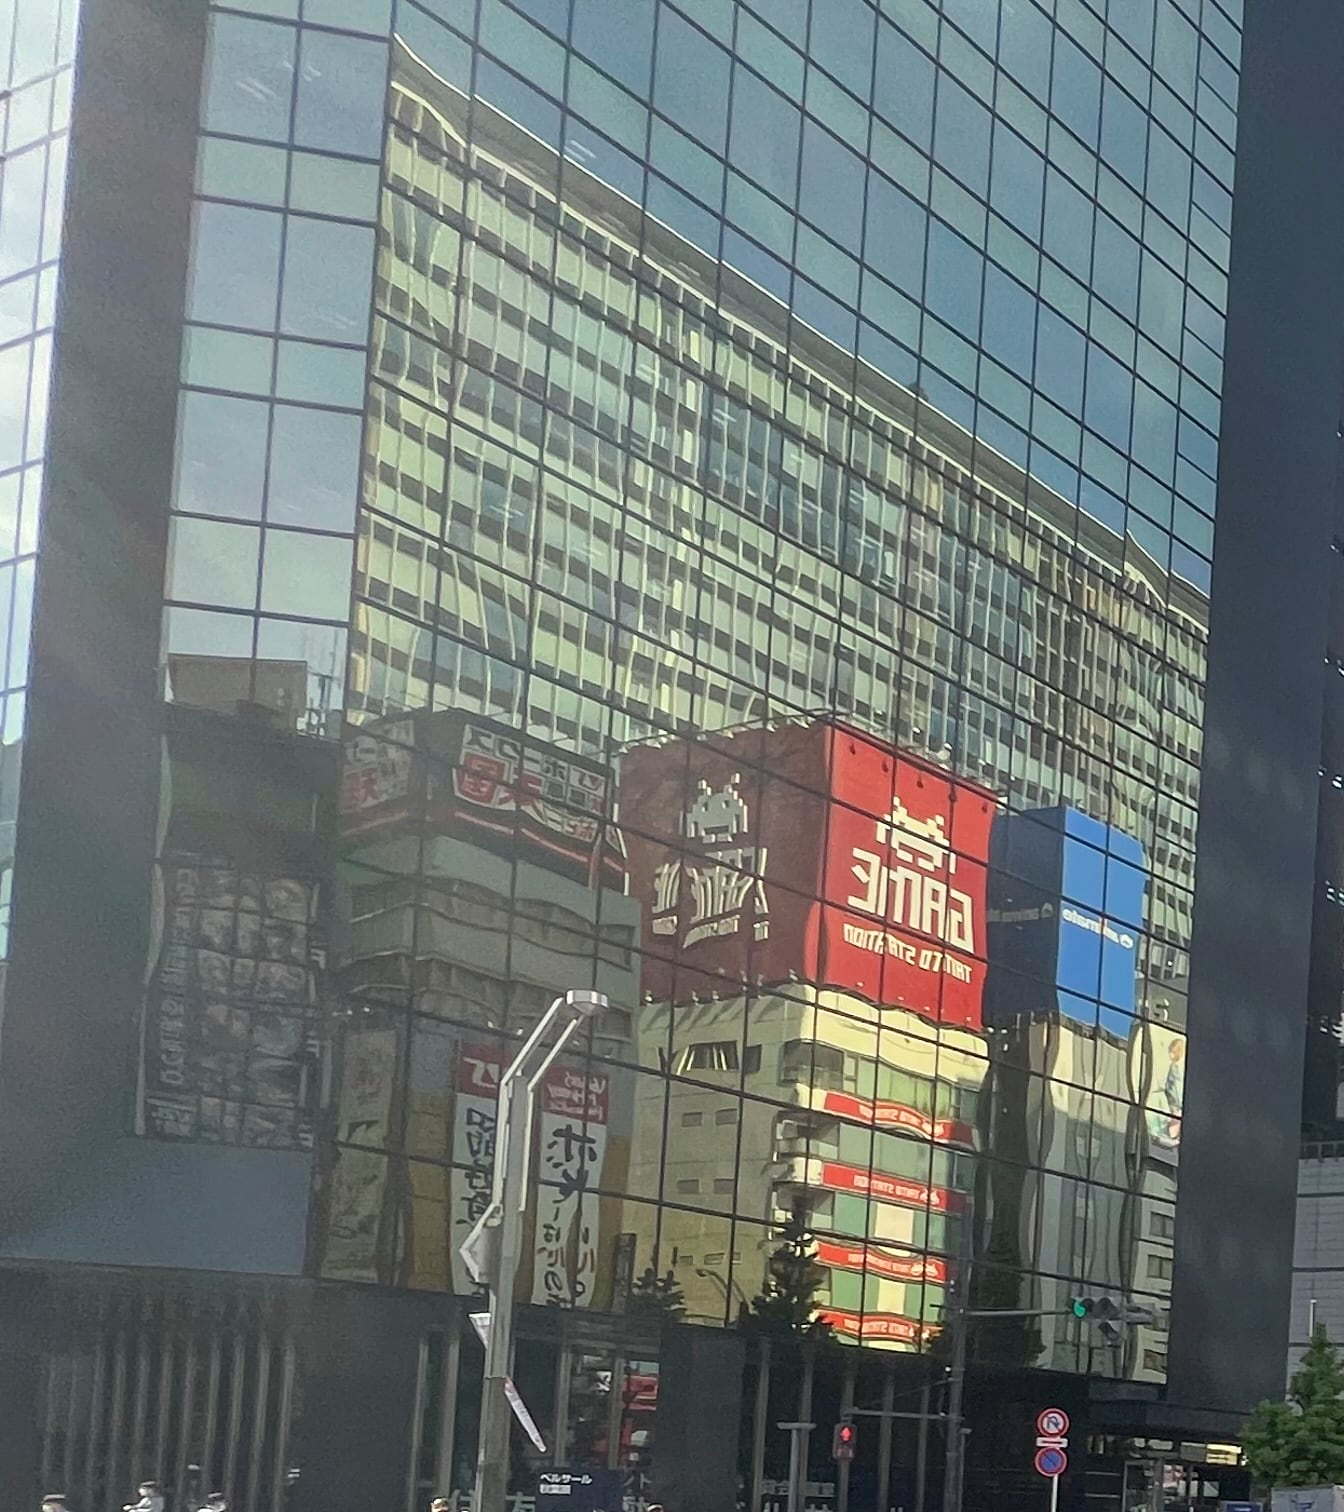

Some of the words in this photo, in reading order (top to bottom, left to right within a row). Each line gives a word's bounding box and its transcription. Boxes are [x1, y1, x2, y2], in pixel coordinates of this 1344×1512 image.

[540, 1473, 593, 1485] ベルサール
